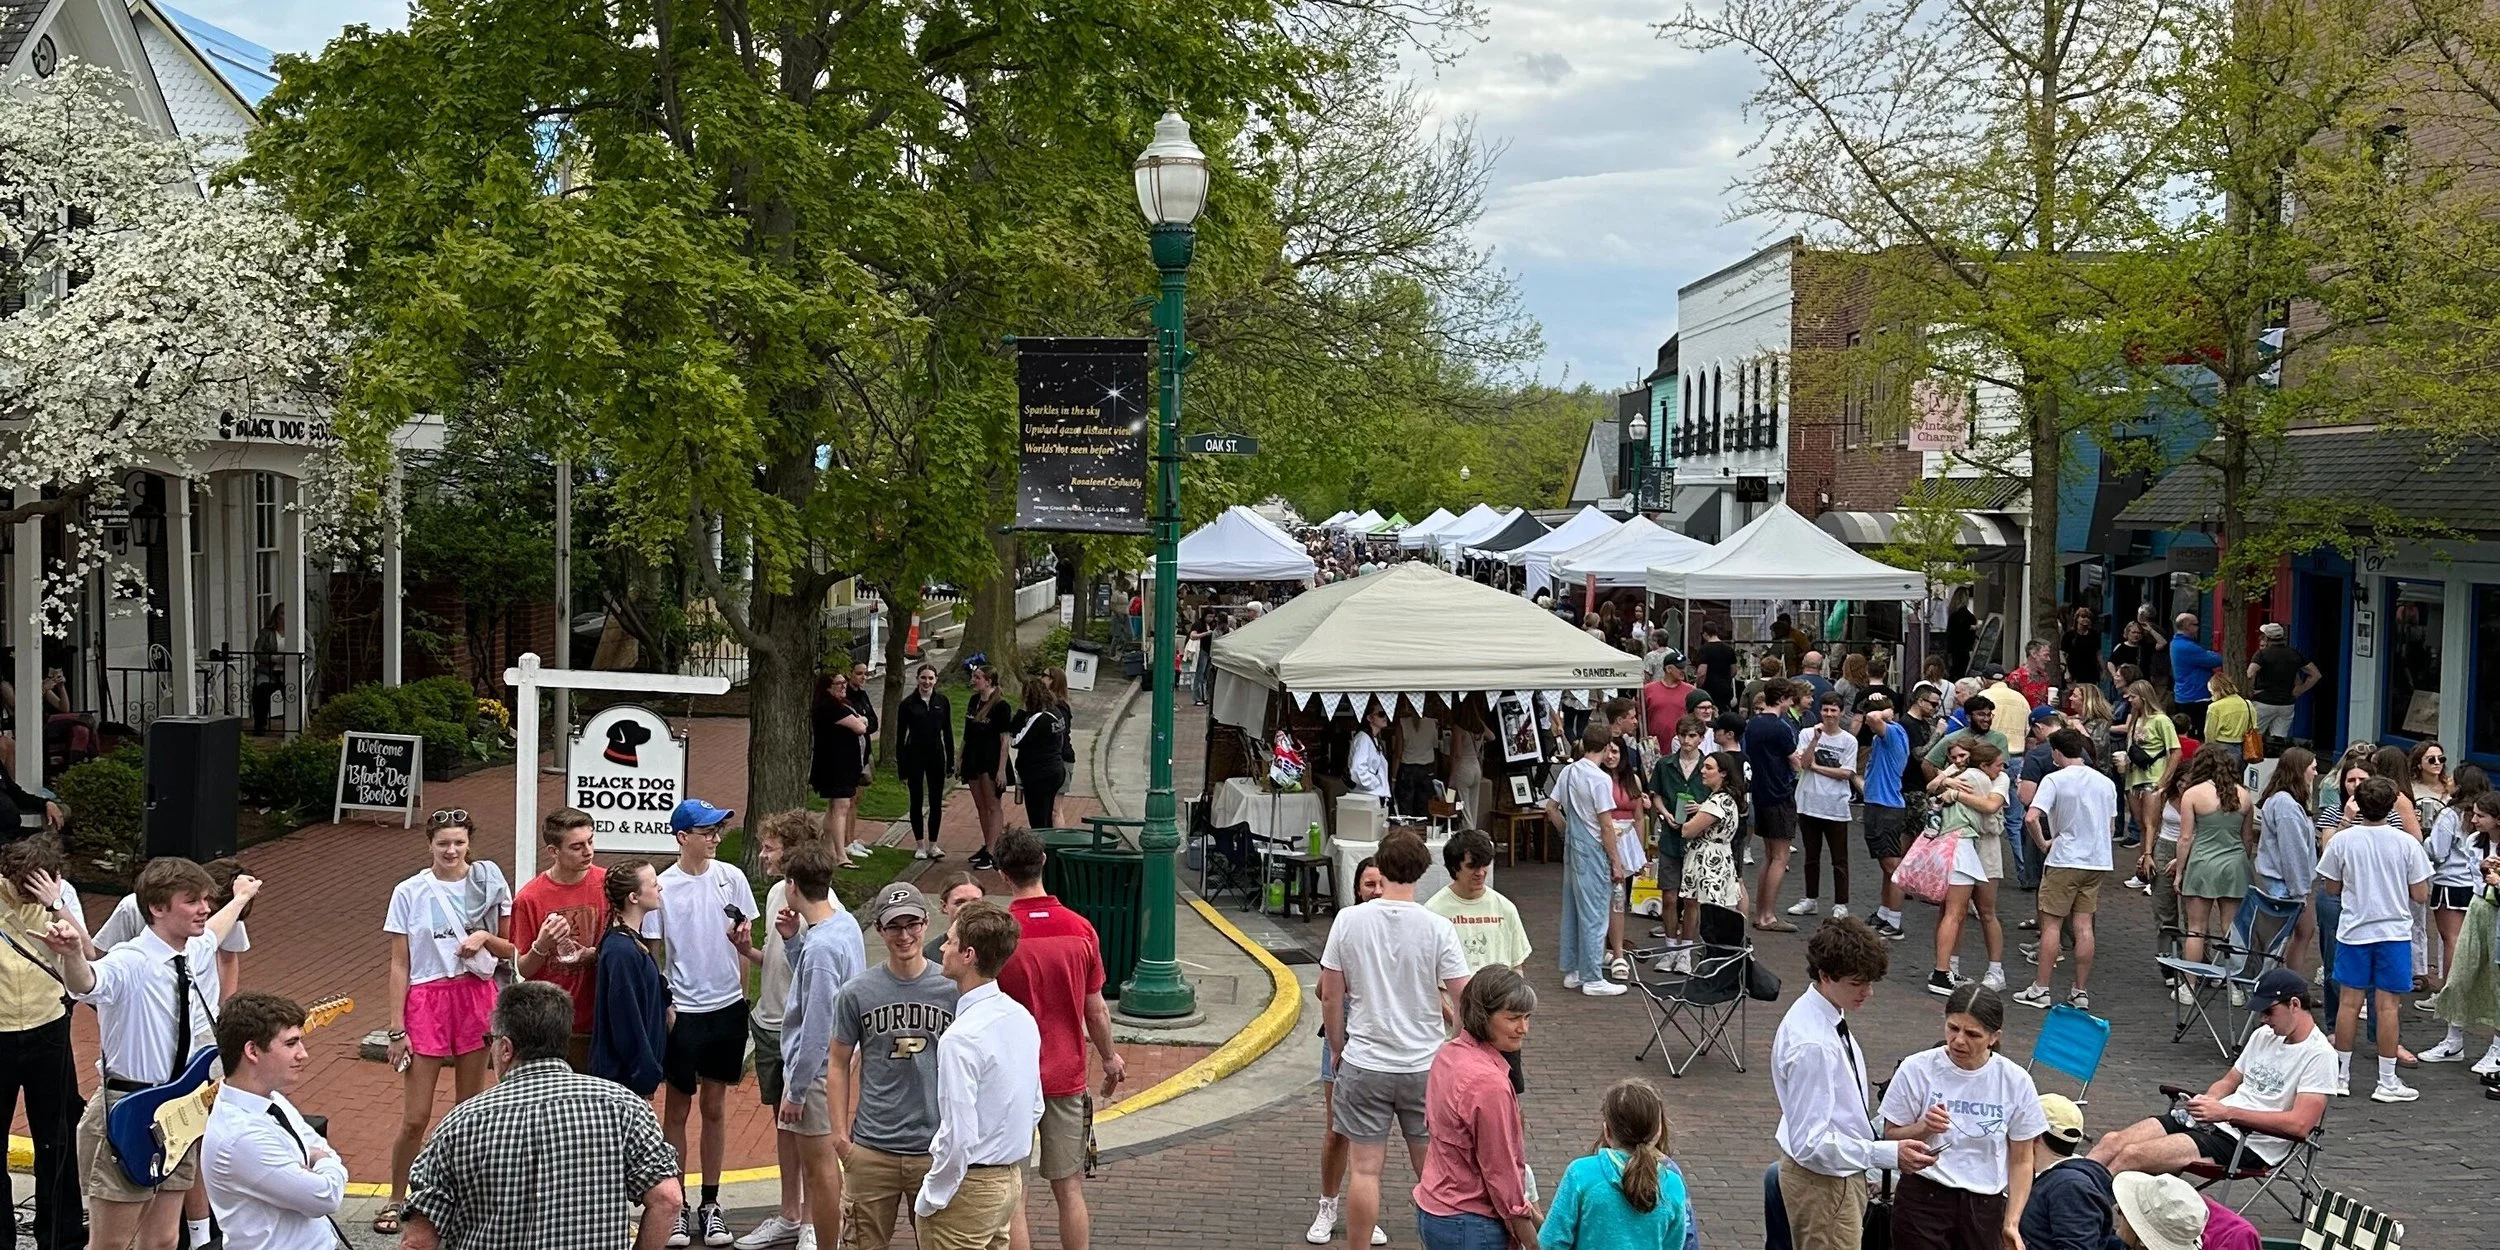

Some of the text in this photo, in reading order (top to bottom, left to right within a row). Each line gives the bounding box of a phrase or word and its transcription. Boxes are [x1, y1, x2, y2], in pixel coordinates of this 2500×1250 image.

[1024, 404, 1101, 419] Sparkles in the sky
[236, 418, 343, 441] BLACK DOG BOO
[1025, 423, 1058, 436] Upward
[1083, 426, 1112, 435] distant
[1918, 432, 1957, 442] Charm
[1025, 443, 1056, 454] Worlds
[1070, 446, 1088, 455] seen
[1089, 444, 1115, 457] before
[1205, 439, 1238, 453] OAK ST.
[1071, 476, 1143, 489] Rosaleen Crowley
[1738, 478, 1767, 491] DUO
[1664, 471, 1673, 511] MARKET
[1583, 668, 1615, 678] GANDER
[357, 738, 404, 757] Welcome
[373, 754, 387, 767] to
[347, 764, 410, 797] Black Dog
[577, 775, 675, 791] BLACK DOG
[356, 784, 397, 806] Books
[577, 790, 674, 812] BOOKS
[618, 820, 630, 834] &
[634, 821, 672, 834] RARE
[888, 890, 910, 904] P
[1449, 915, 1505, 925] ulbasaur
[860, 1002, 955, 1041] PURDUE
[888, 1036, 929, 1061] P
[1928, 1096, 2004, 1119] PPERCUTS
